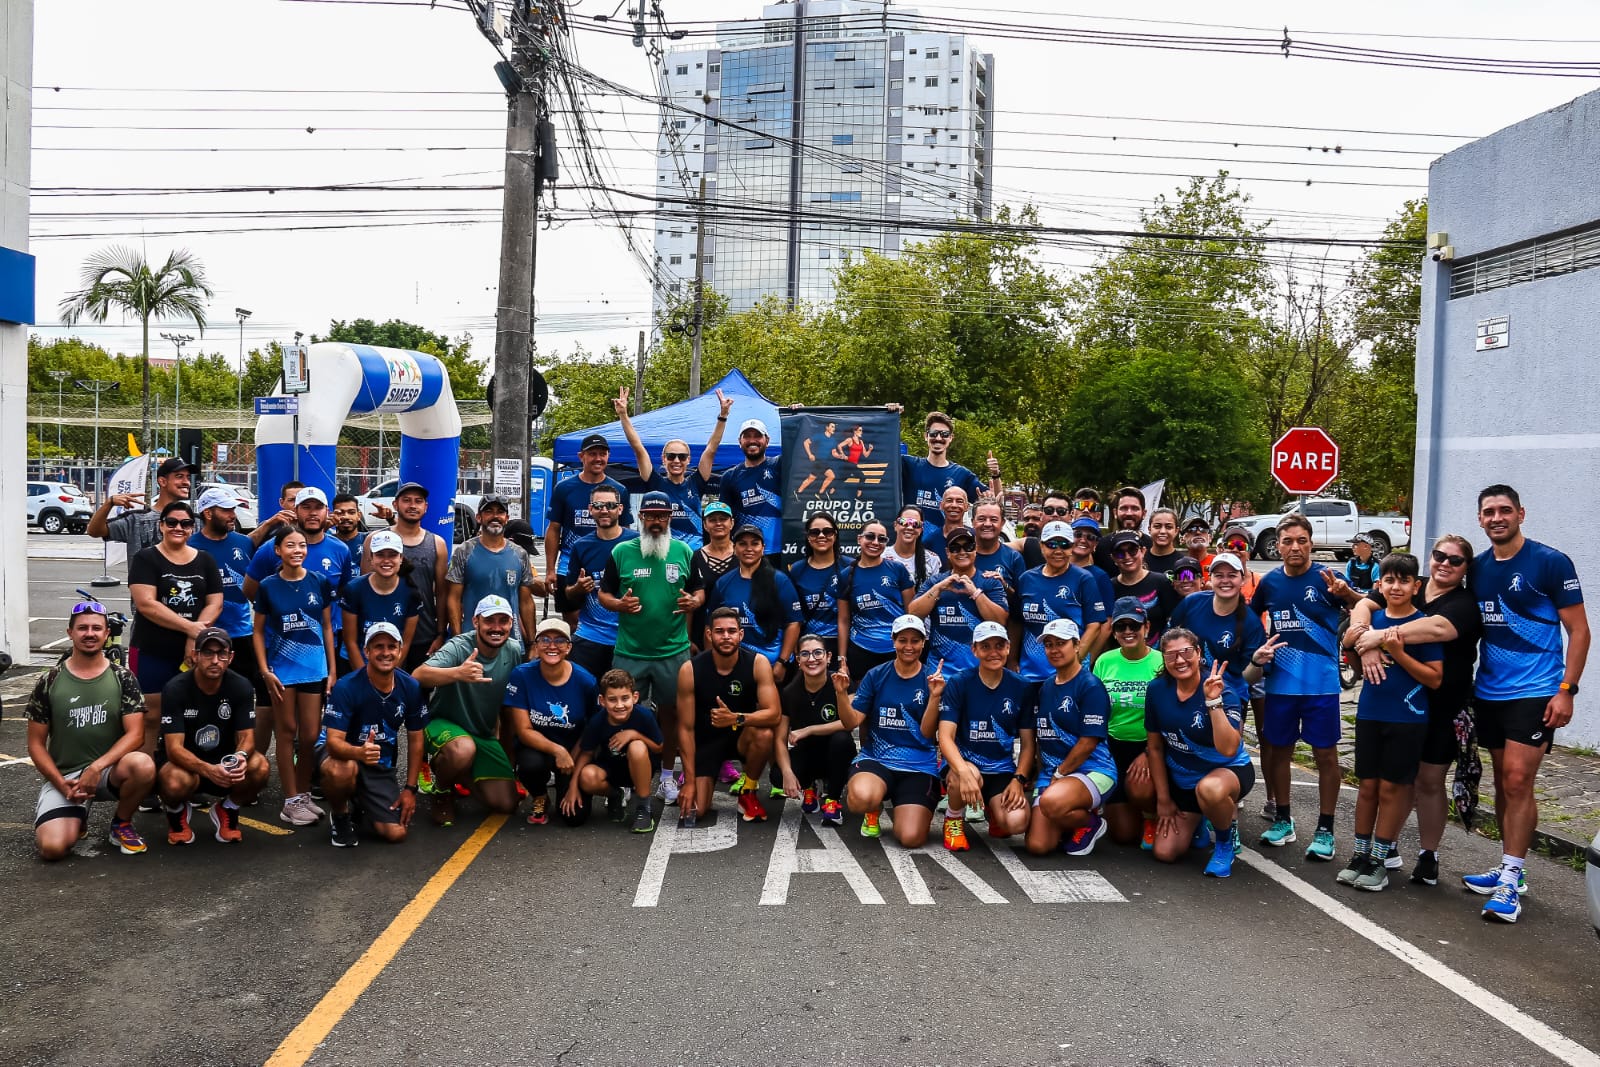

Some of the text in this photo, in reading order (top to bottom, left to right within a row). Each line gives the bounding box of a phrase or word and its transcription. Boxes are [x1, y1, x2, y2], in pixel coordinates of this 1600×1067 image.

[387, 388, 420, 402] SMESP
[1276, 451, 1333, 470] PARE
[806, 500, 874, 510] GRUPO DE
[782, 543, 797, 554] Já
[886, 718, 906, 727] RADIO
[978, 731, 996, 739] RADIO
